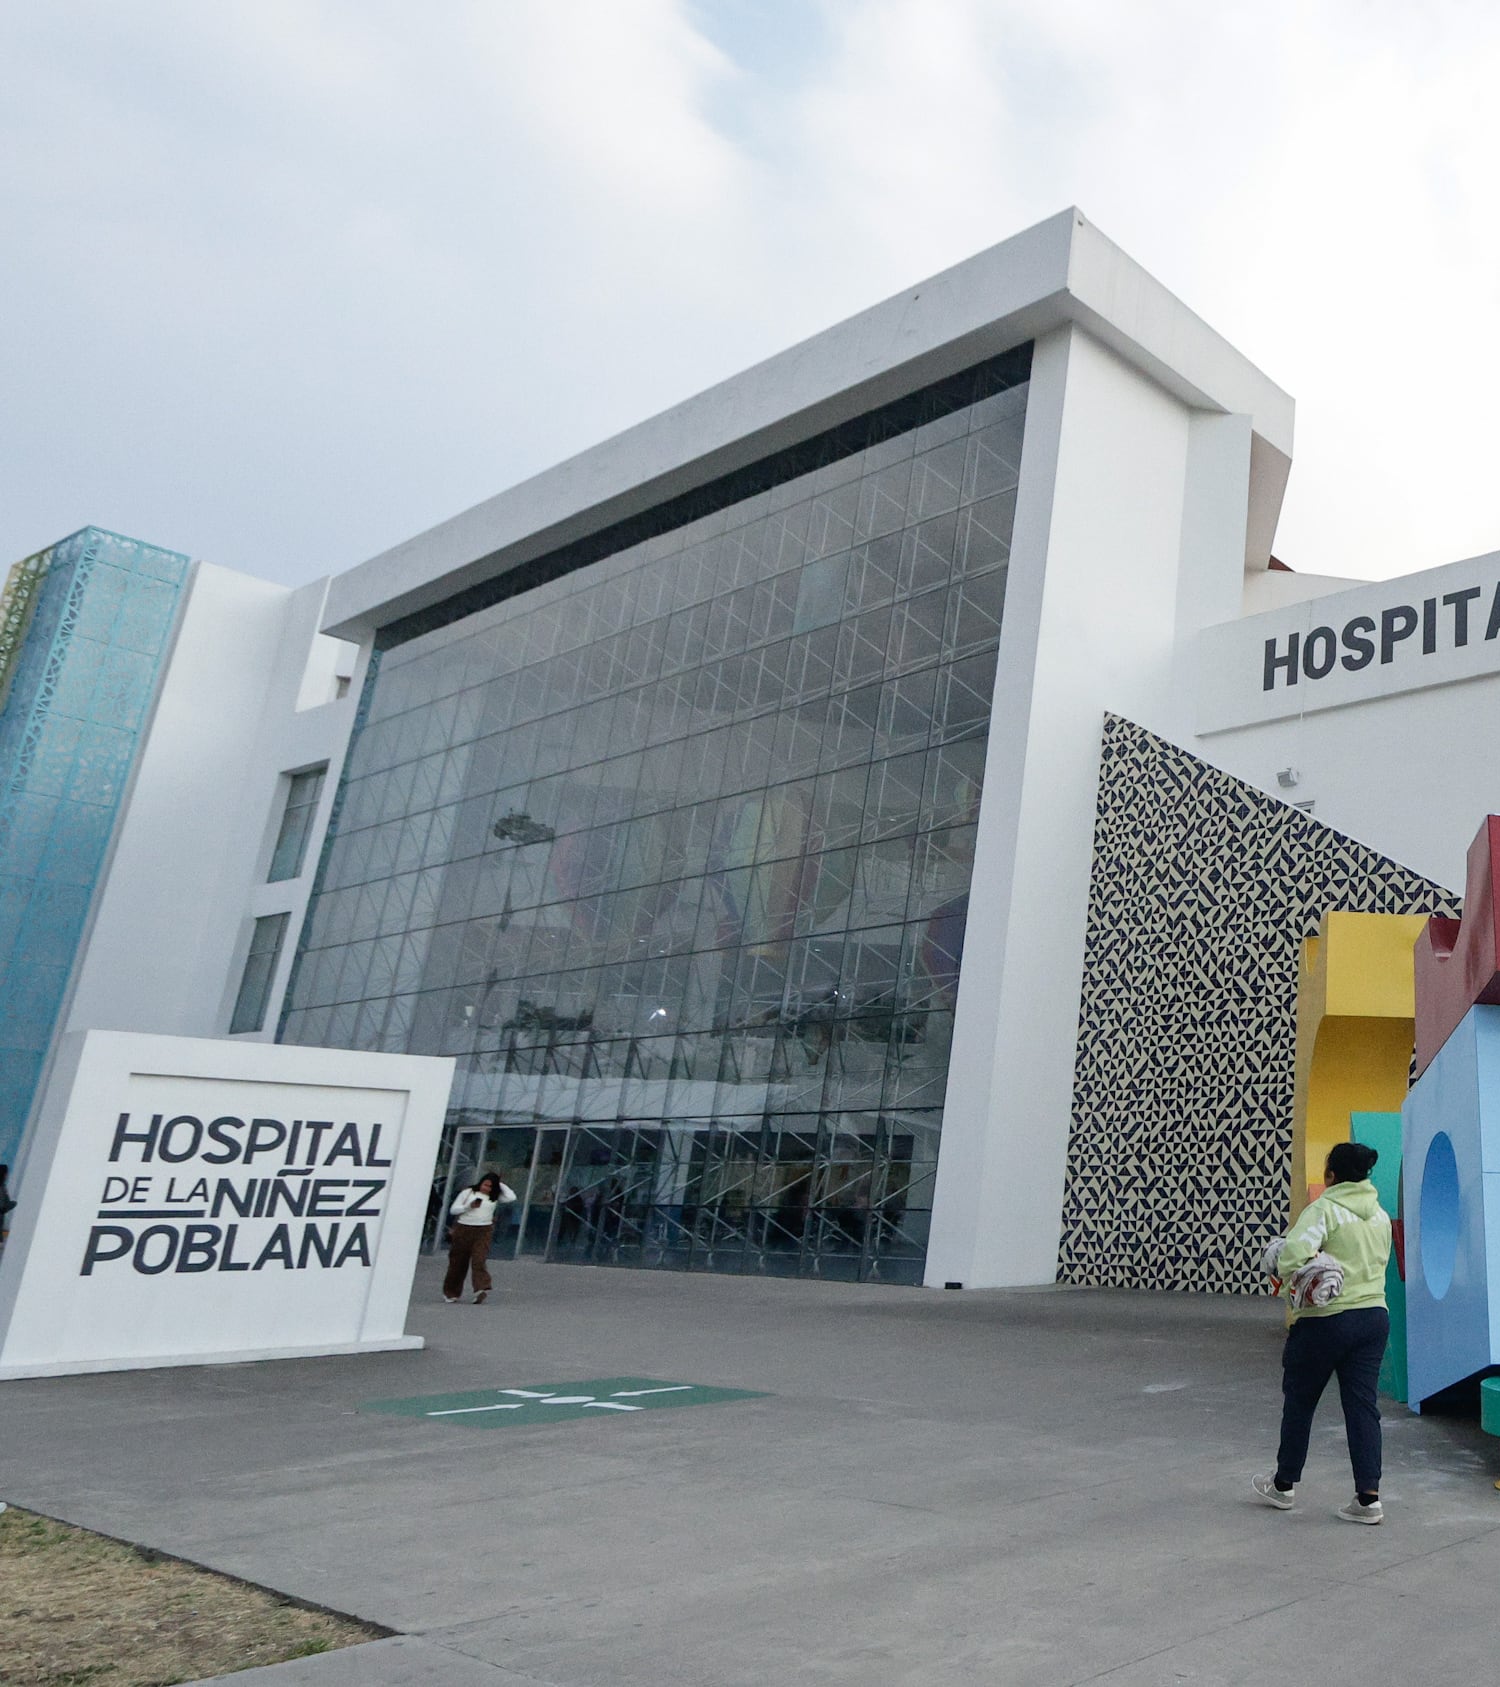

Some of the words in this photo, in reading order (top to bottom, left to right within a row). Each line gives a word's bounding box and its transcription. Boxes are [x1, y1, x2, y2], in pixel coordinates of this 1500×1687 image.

[107, 1112, 392, 1168] HOSPITAL
[101, 1176, 152, 1203] DE
[165, 1177, 208, 1203] LA
[210, 1168, 387, 1219] NIÑEZ
[79, 1222, 372, 1277] POBLANA
